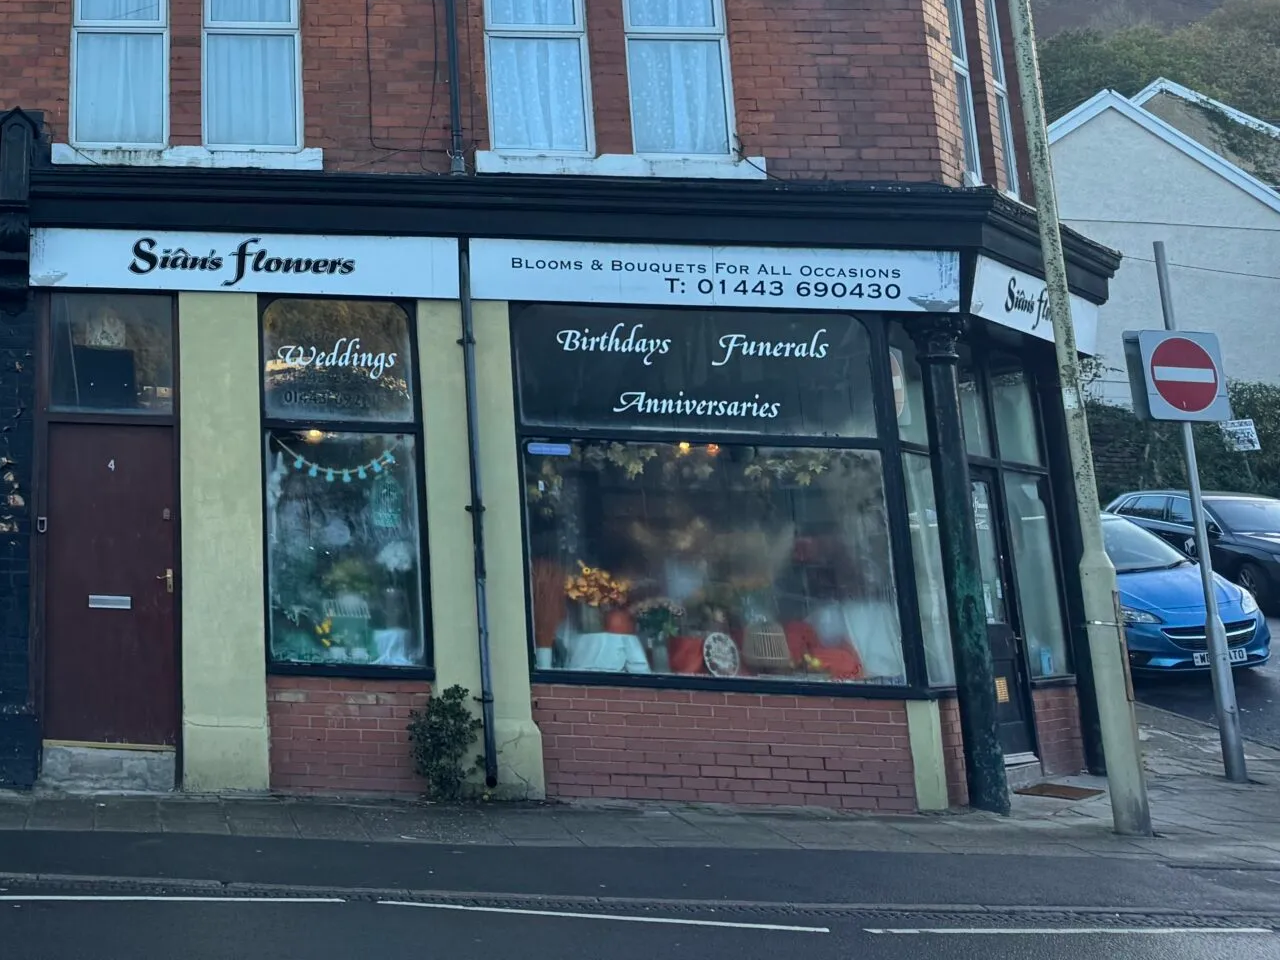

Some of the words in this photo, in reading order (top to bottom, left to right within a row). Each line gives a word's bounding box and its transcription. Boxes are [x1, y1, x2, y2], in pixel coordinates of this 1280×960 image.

[128, 237, 224, 276] Siân's
[590, 259, 603, 271] &
[664, 277, 686, 294] T:
[697, 278, 785, 297] 01443
[795, 280, 902, 300] 690430
[555, 322, 672, 366] Birthdays
[711, 328, 830, 366] Funerals
[277, 337, 398, 380] Weddings
[612, 391, 782, 419] Anniversaries
[107, 459, 115, 471] 4
